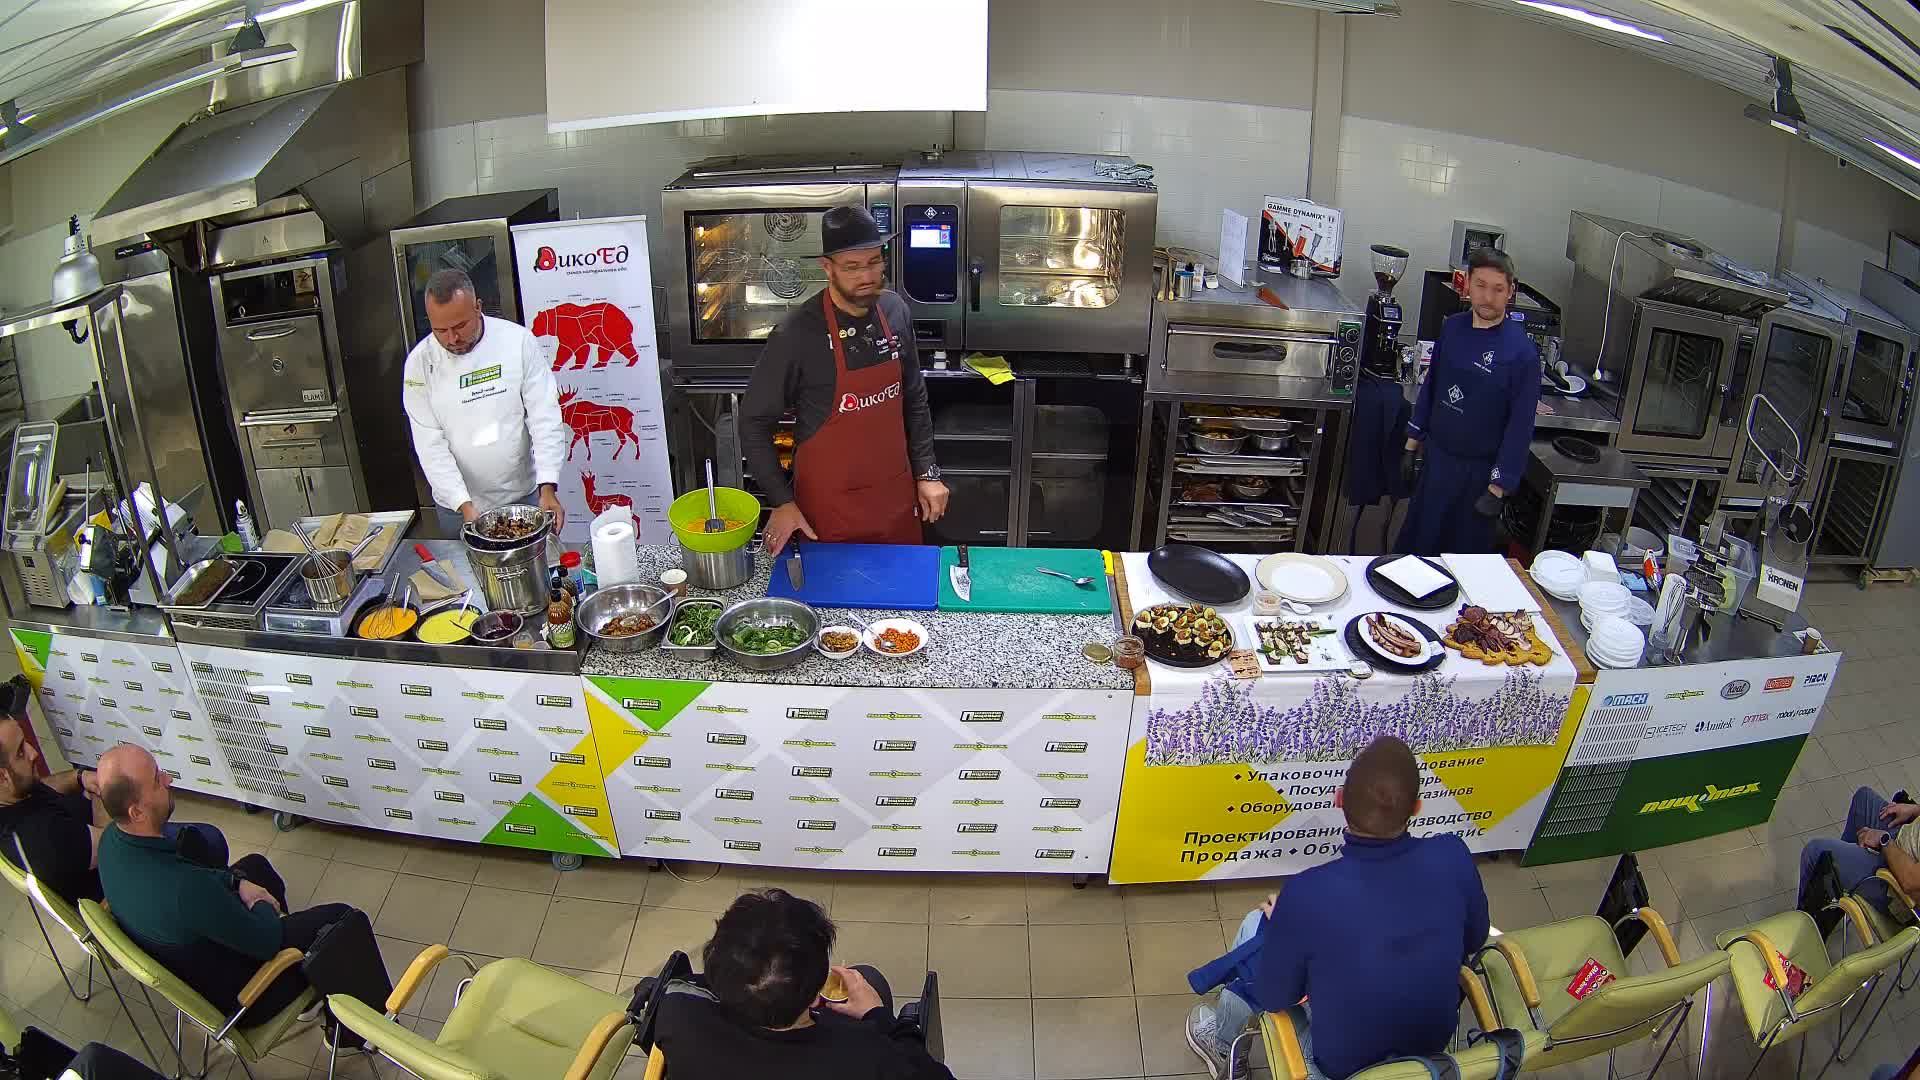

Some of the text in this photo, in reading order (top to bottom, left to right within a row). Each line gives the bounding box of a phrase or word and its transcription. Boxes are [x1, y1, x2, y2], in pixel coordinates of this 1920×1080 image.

[1267, 203, 1292, 214] GAMME
[1768, 575, 1799, 592] KRONEN
[1612, 693, 1647, 706] MACH
[1289, 784, 1344, 797] Посуд
[1240, 800, 1336, 814] Оборудова
[1180, 847, 1283, 865] Продажа
